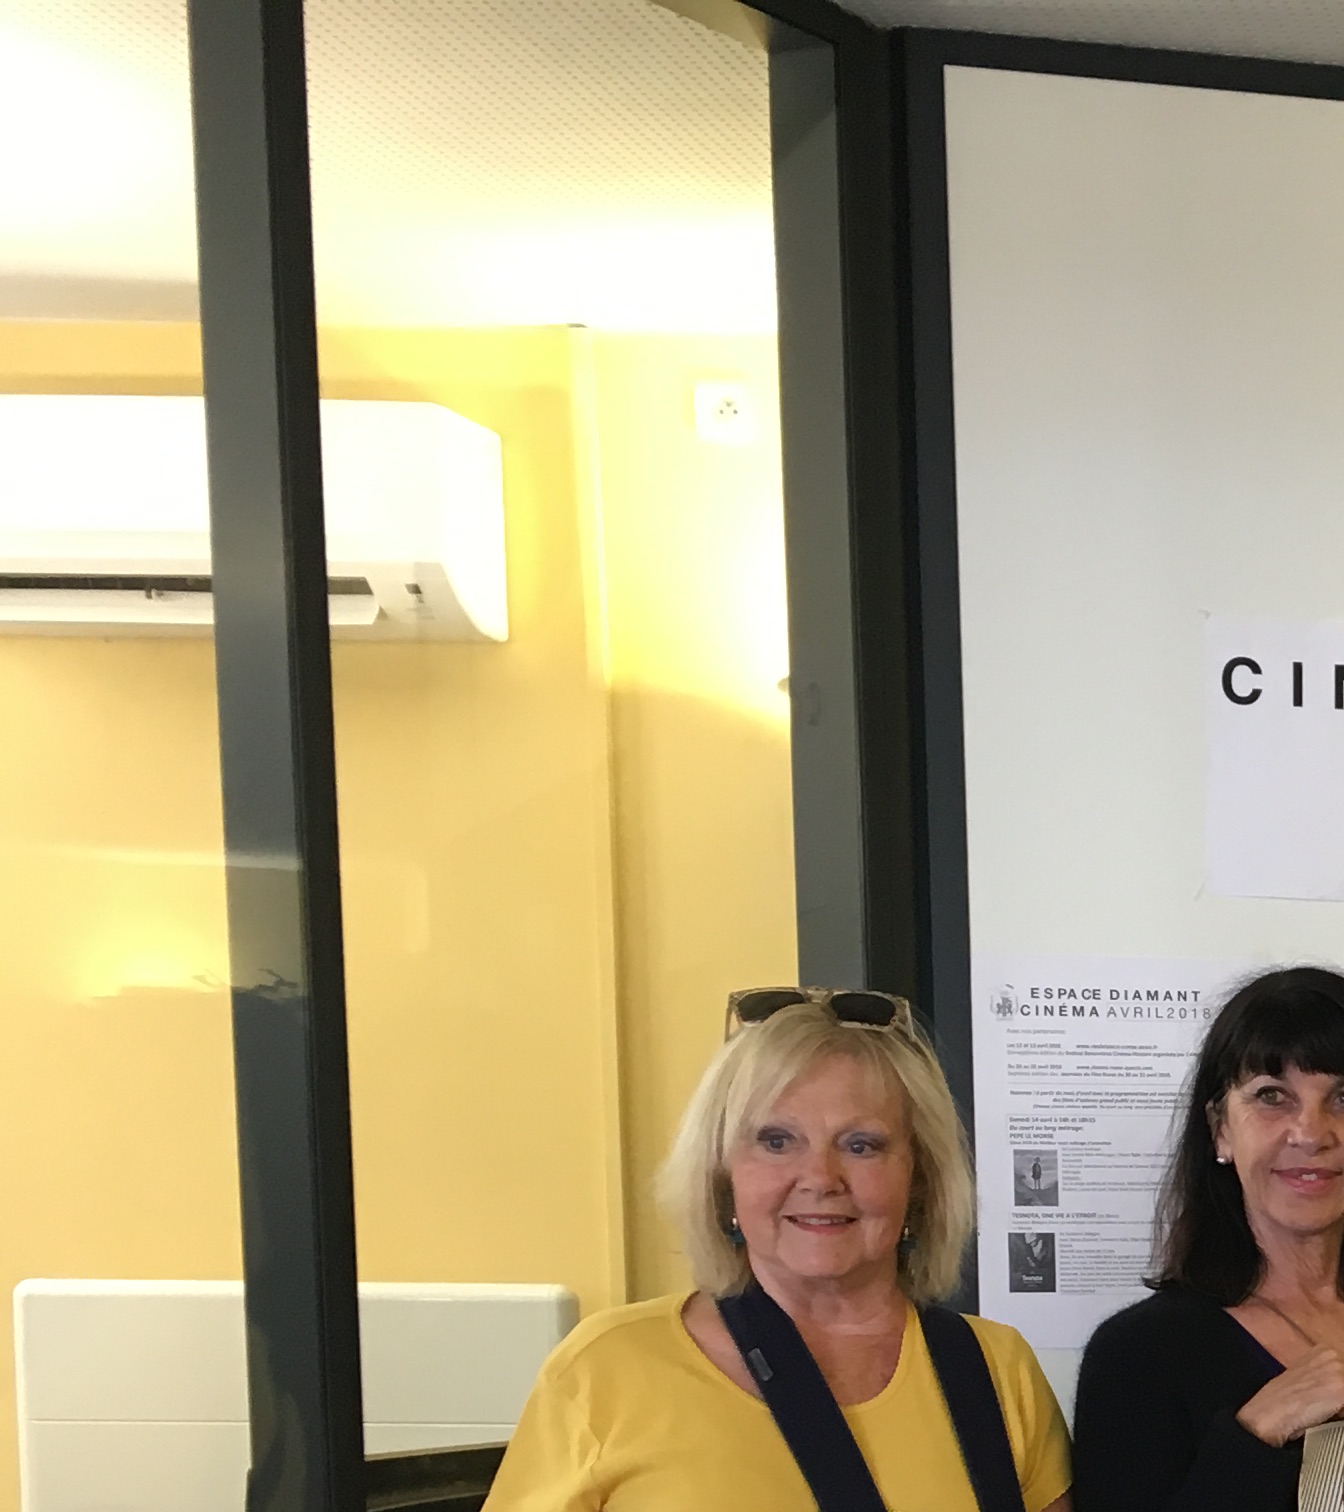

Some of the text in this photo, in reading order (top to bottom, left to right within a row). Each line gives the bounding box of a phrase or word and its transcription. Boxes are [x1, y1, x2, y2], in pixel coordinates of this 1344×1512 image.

[1030, 988, 1201, 1002] ESPACE DIAMANT
[1020, 1002, 1100, 1017] CINÉMA
